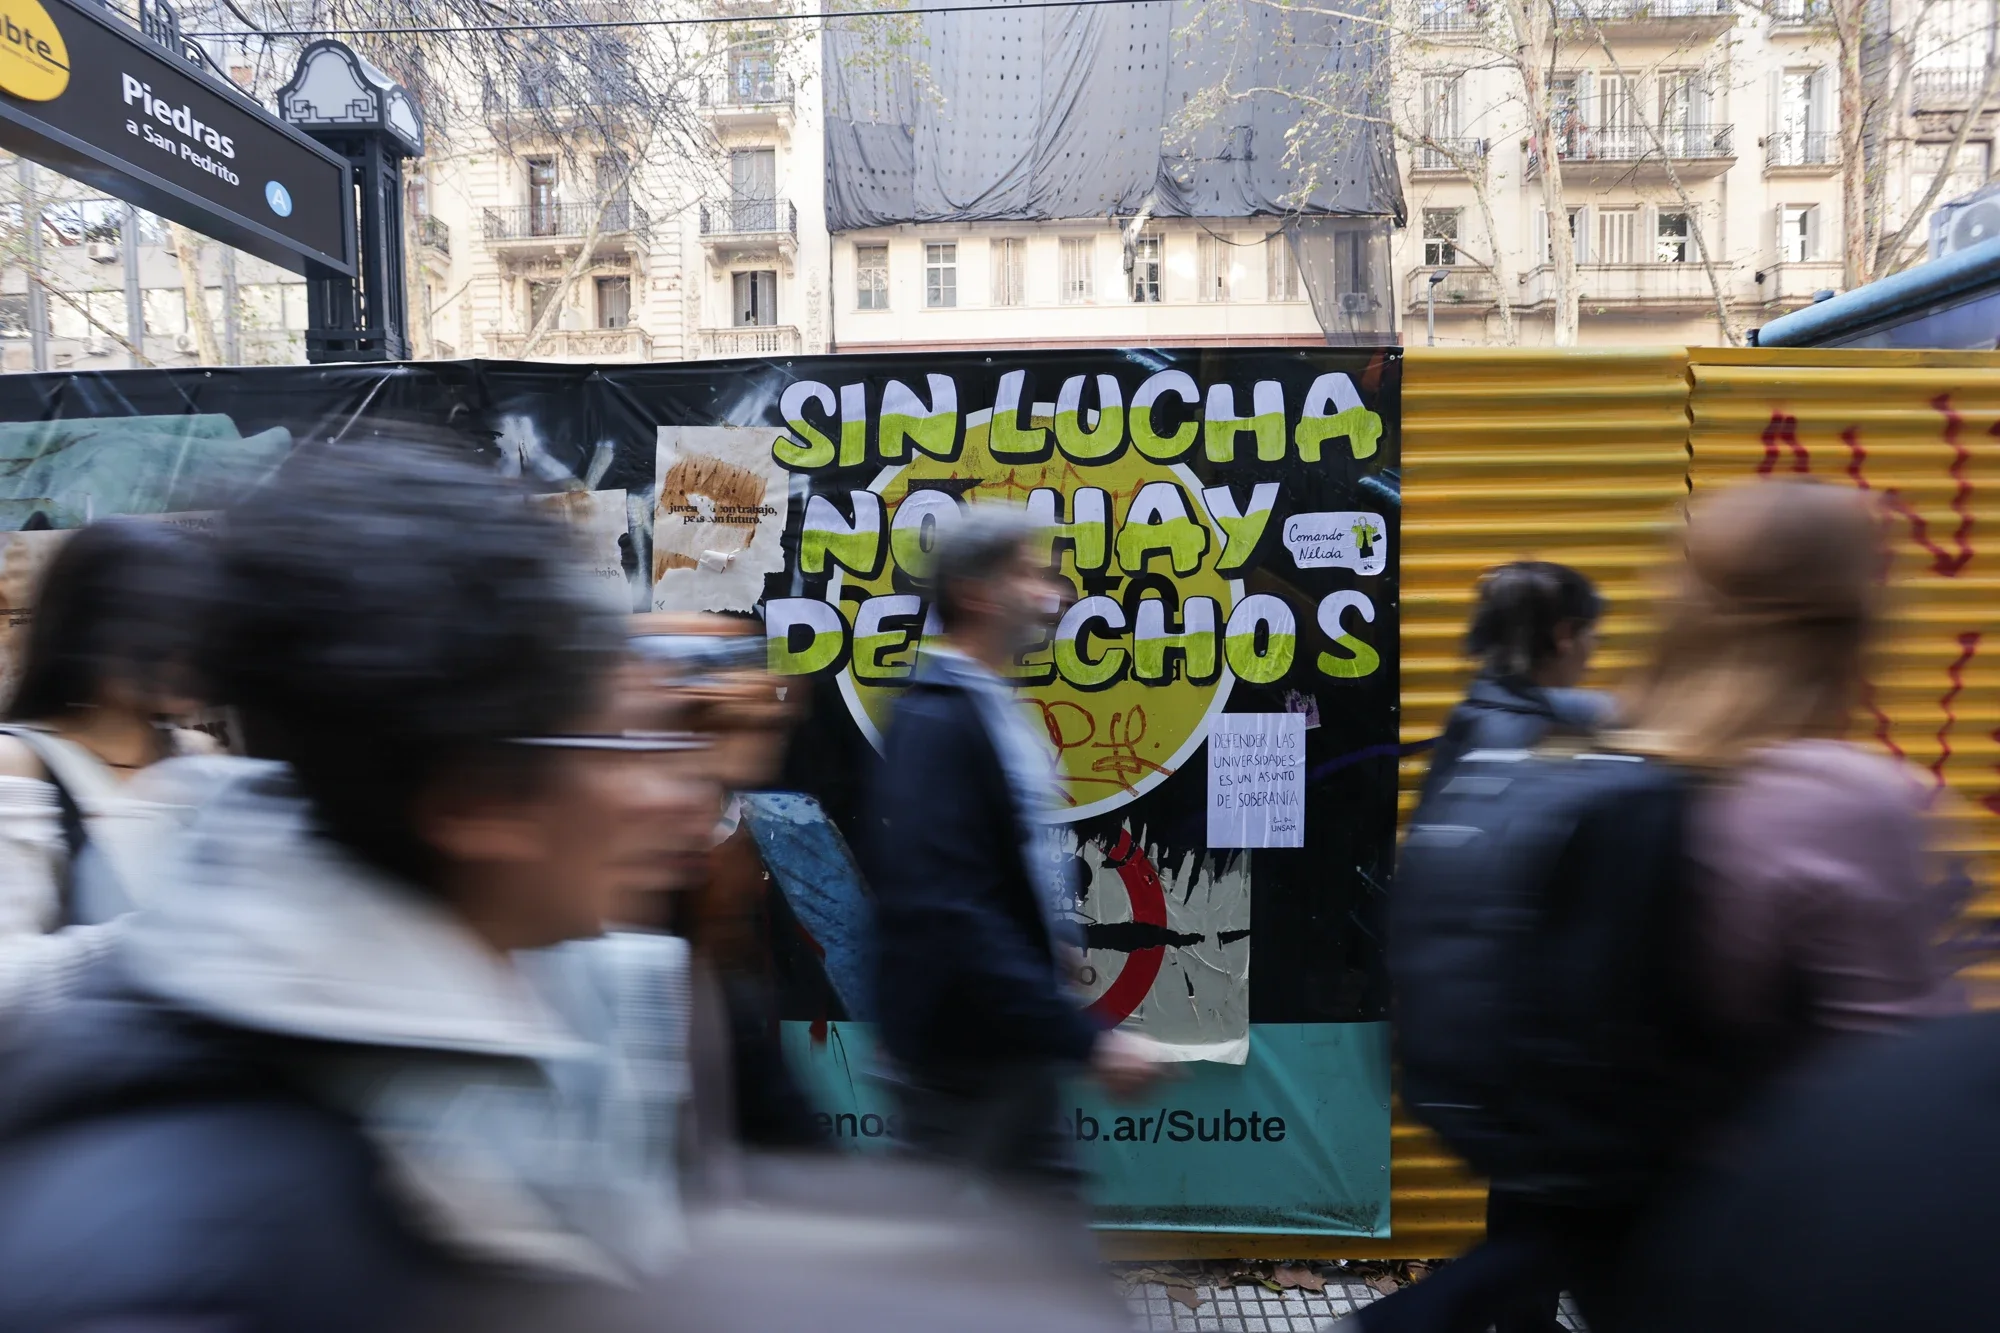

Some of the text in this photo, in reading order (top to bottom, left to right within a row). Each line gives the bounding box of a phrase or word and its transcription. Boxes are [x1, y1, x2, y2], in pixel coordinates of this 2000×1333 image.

[0, 13, 62, 64] bte
[122, 72, 235, 159] Piedras
[126, 119, 240, 186] a San Pedrito
[772, 370, 1382, 467] SIN LUCHA
[726, 514, 762, 524] futuro.
[737, 504, 778, 516] trabajo,
[1027, 482, 1280, 573] HAY
[1289, 523, 1345, 542] Comando
[1299, 547, 1344, 560] Nélida
[1214, 733, 1295, 749] DEFENDER LAS
[1219, 771, 1295, 786] ES UN ASUNTO
[1217, 790, 1298, 809] DE SOBERANÍA
[1271, 824, 1297, 832] UNSAM
